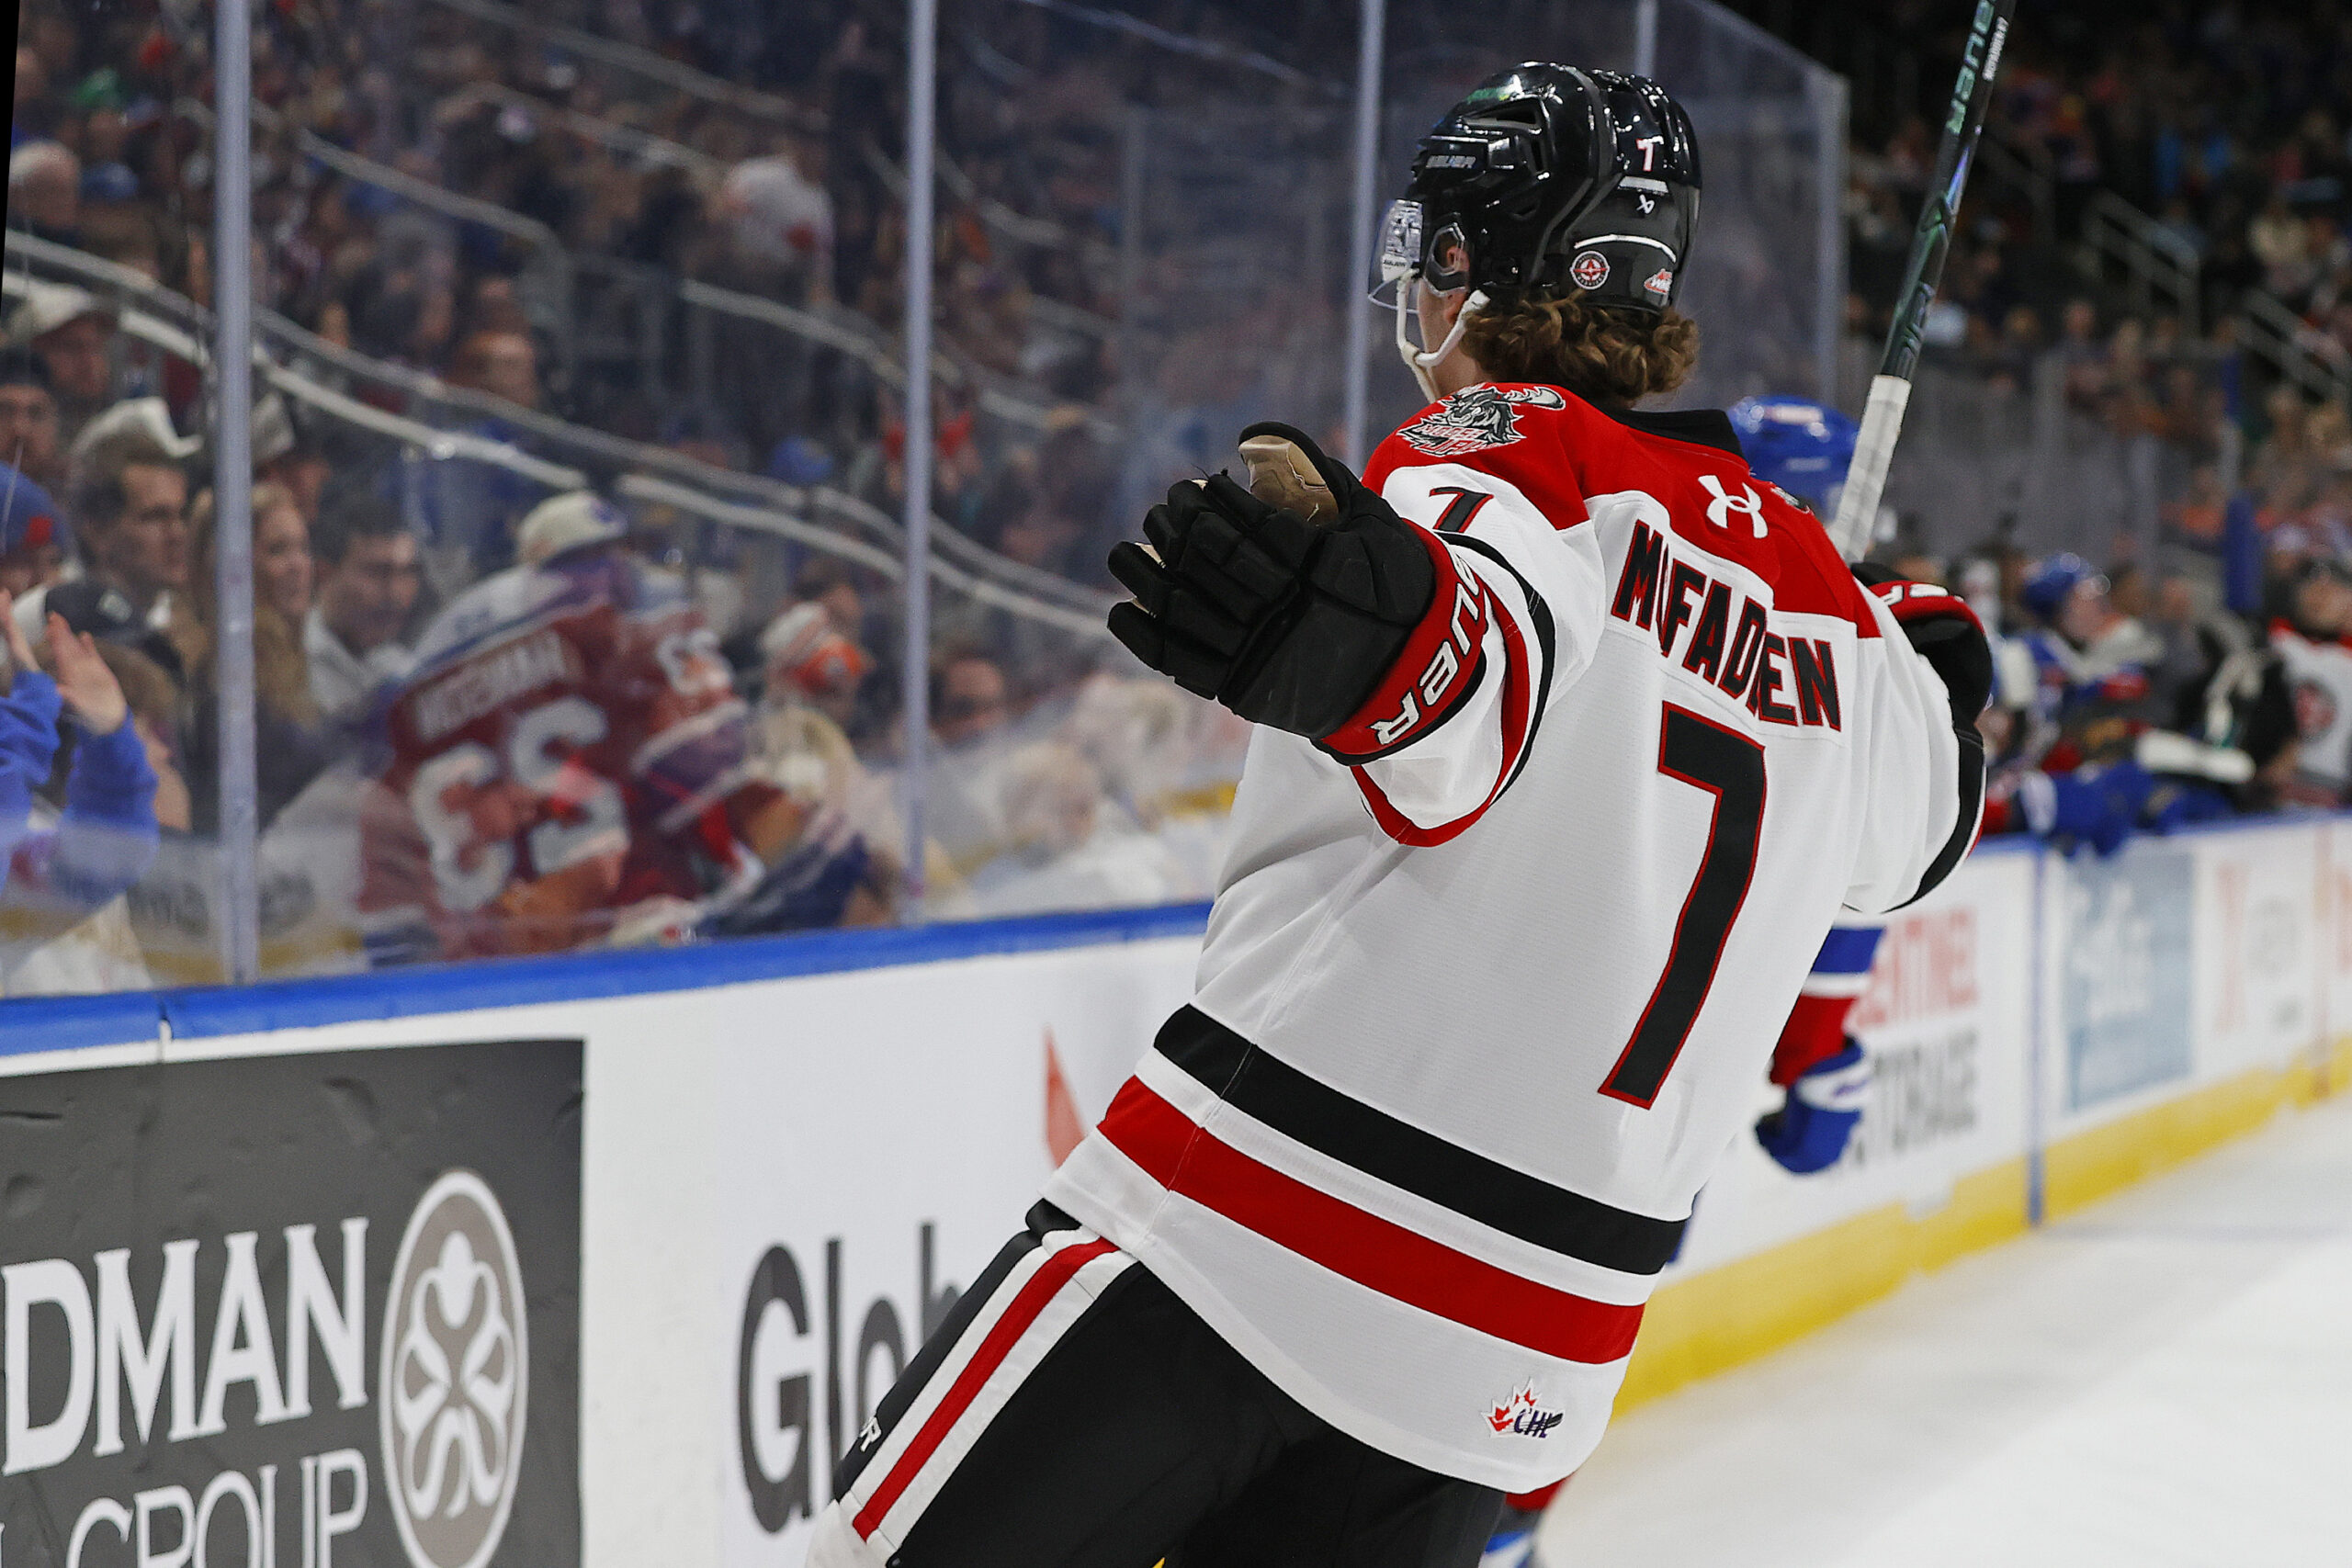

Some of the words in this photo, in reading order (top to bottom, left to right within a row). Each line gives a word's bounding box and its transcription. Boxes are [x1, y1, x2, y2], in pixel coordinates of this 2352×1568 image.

[1947, 0, 1996, 135] AUER
[1635, 137, 1656, 172] 7
[1430, 486, 1494, 533] 7
[1611, 519, 1841, 732] MFADEN
[1598, 700, 1766, 1110] 7
[1852, 905, 1980, 1031] ENTINEL
[1850, 1027, 1980, 1167] TORAGE
[2, 1216, 368, 1473] DMAN
